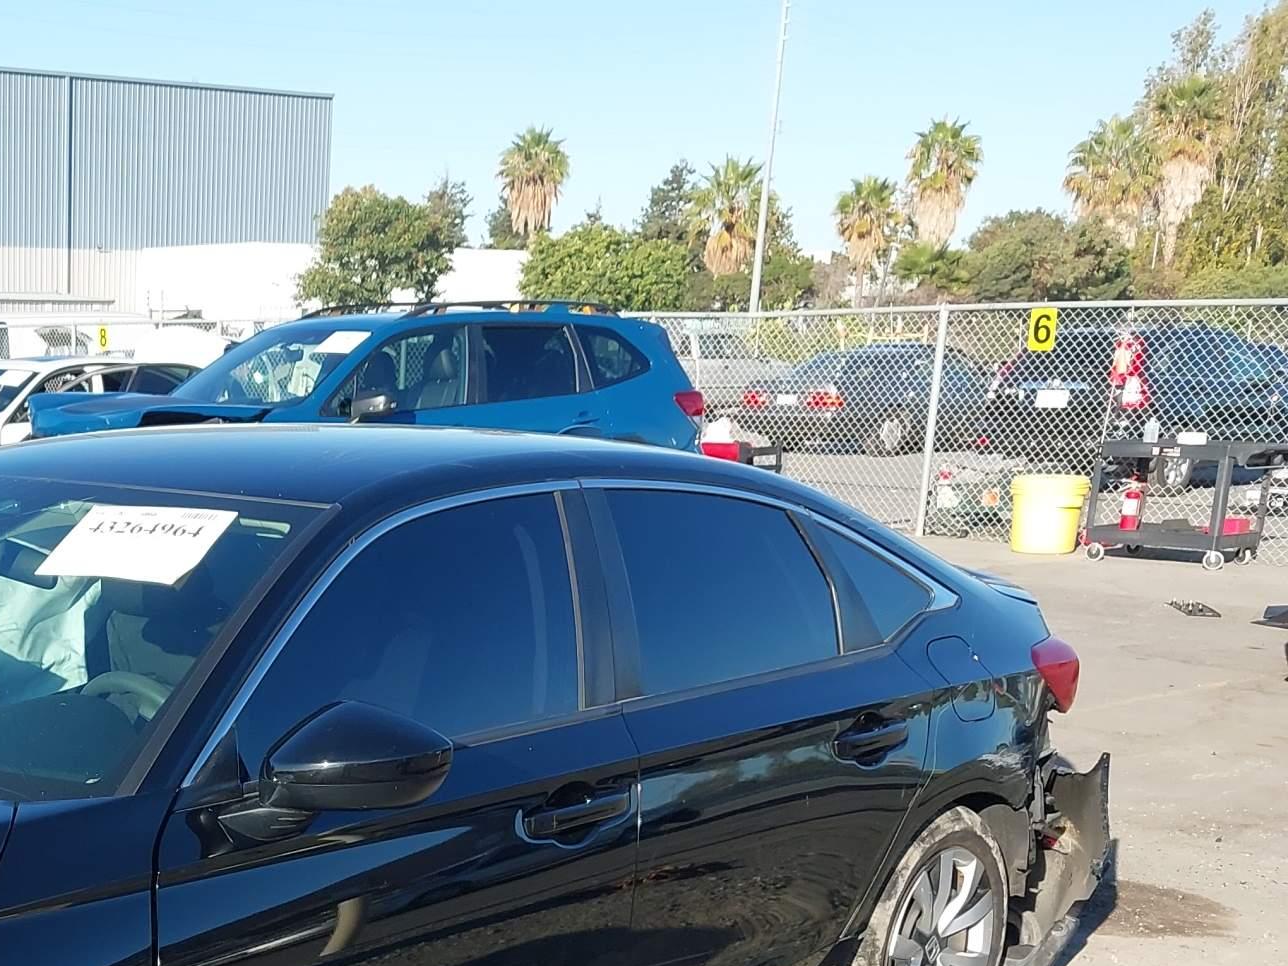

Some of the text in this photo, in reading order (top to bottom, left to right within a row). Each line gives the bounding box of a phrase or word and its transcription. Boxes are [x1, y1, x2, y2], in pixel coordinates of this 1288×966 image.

[99, 328, 107, 347] 8
[1033, 313, 1052, 344] 6
[88, 520, 206, 538] 43264964
